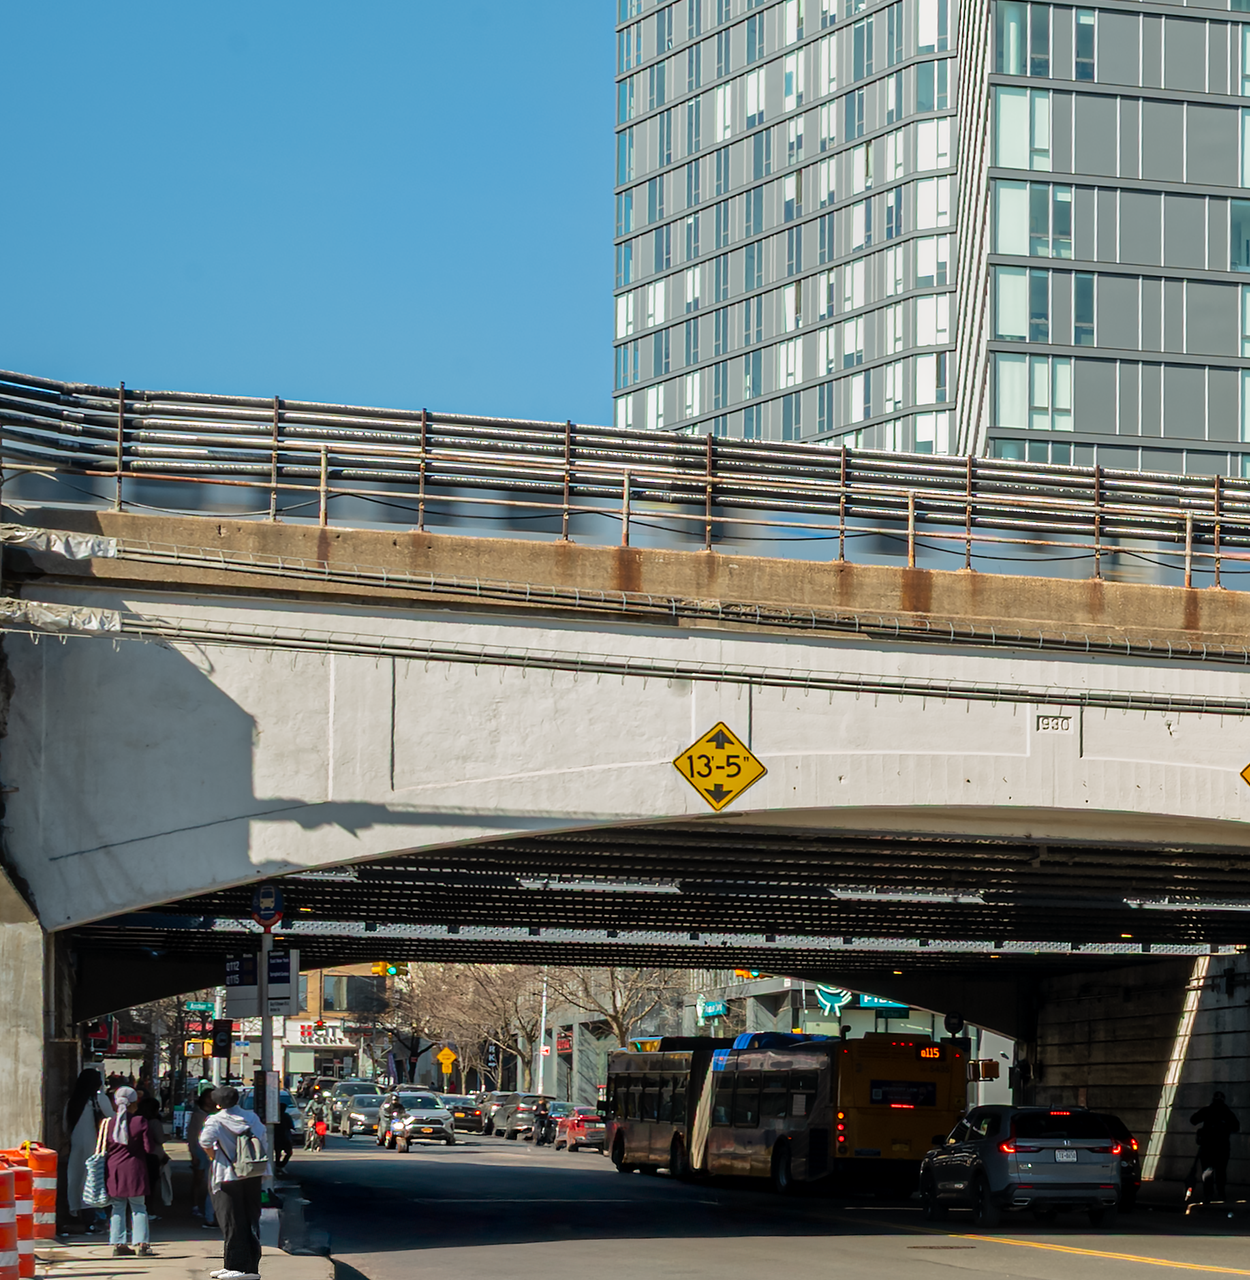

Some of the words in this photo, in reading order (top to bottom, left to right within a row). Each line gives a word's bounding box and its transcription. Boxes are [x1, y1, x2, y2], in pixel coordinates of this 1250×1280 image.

[1036, 716, 1070, 731] 1930
[686, 754, 750, 778] 13'-5"
[226, 961, 240, 972] Q112
[226, 974, 240, 985] Q115
[300, 1036, 345, 1045] URGENT
